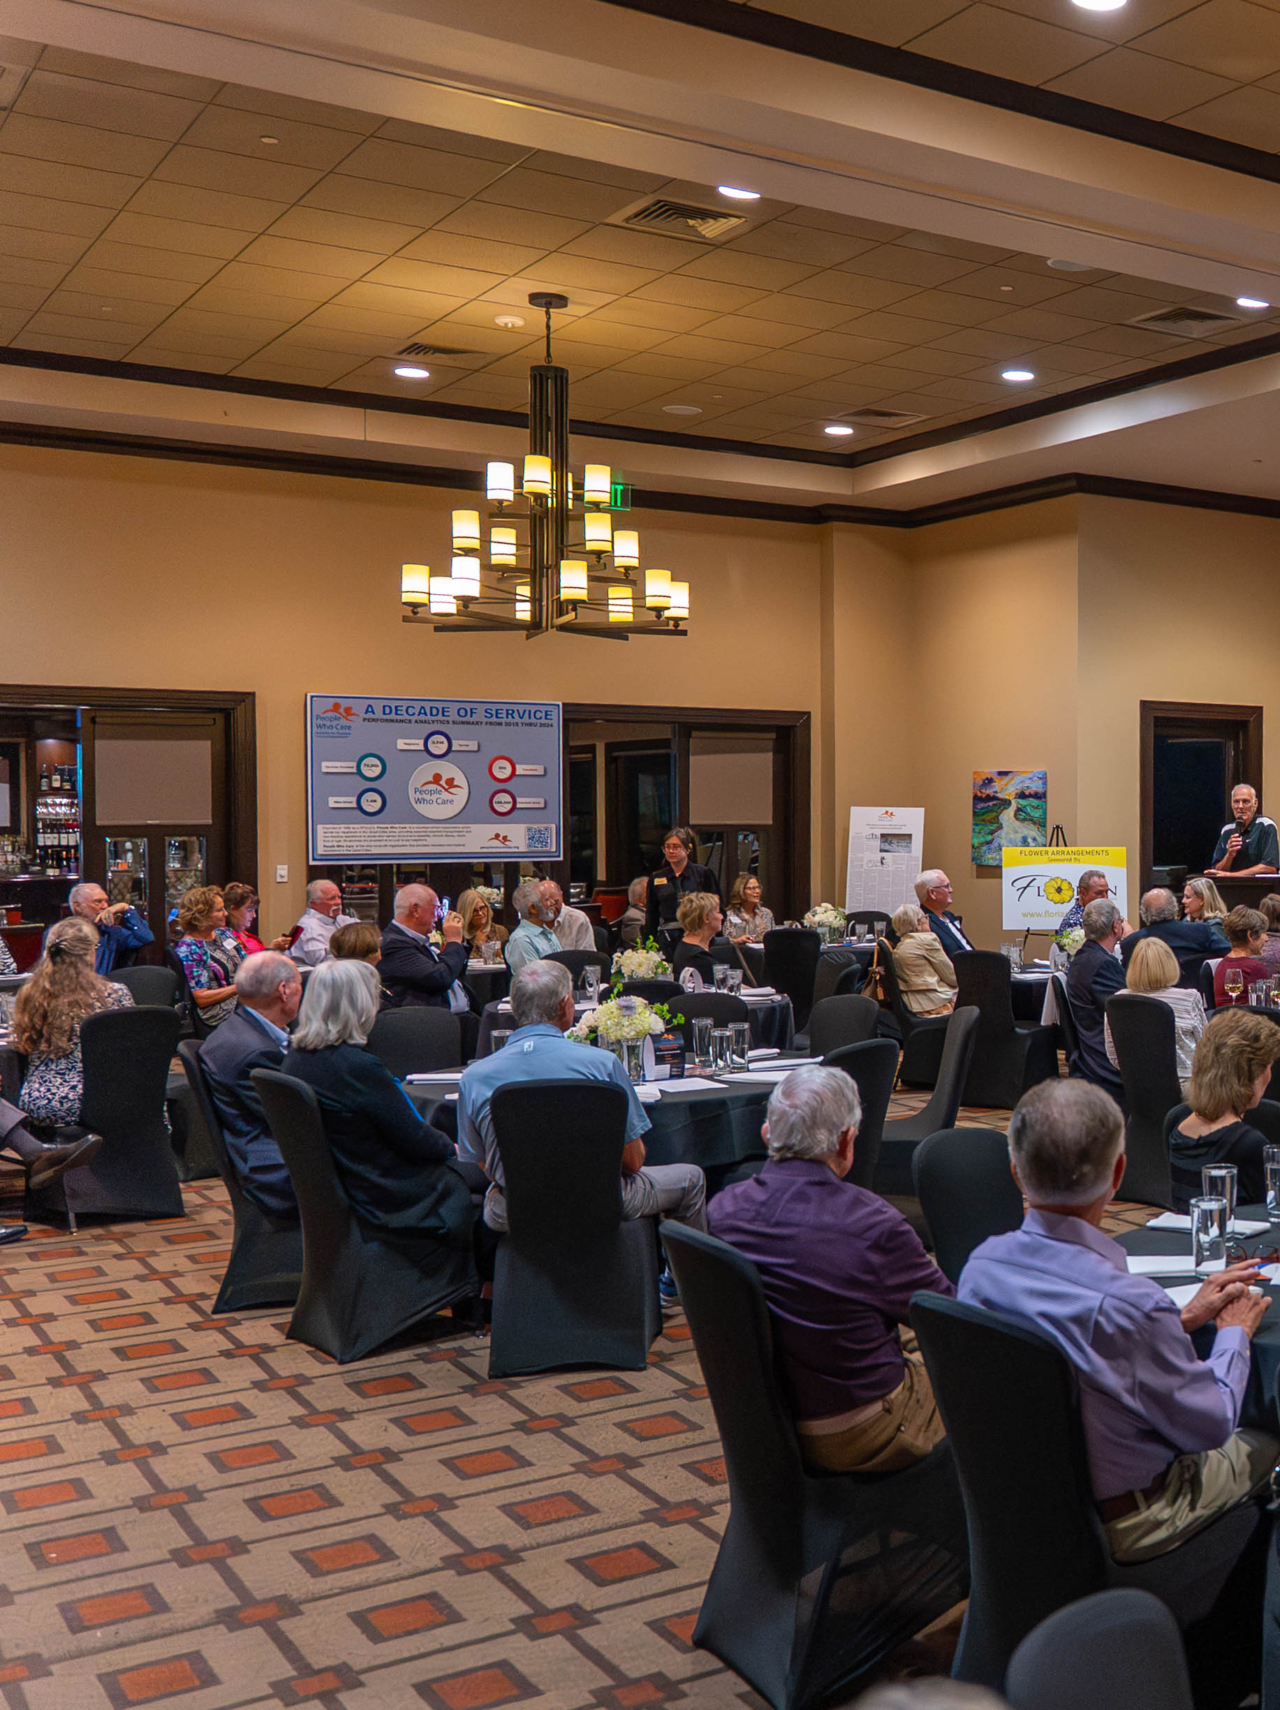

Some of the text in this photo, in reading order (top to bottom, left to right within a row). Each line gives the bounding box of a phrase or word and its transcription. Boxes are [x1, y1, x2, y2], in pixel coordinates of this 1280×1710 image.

[364, 704, 554, 720] A DECADE OF SERVICE
[316, 714, 341, 722] People
[335, 723, 352, 731] Care
[414, 787, 443, 797] People
[414, 797, 454, 805] Who Care
[1021, 910, 1066, 918] www.floria
[523, 1041, 533, 1052] FJ
